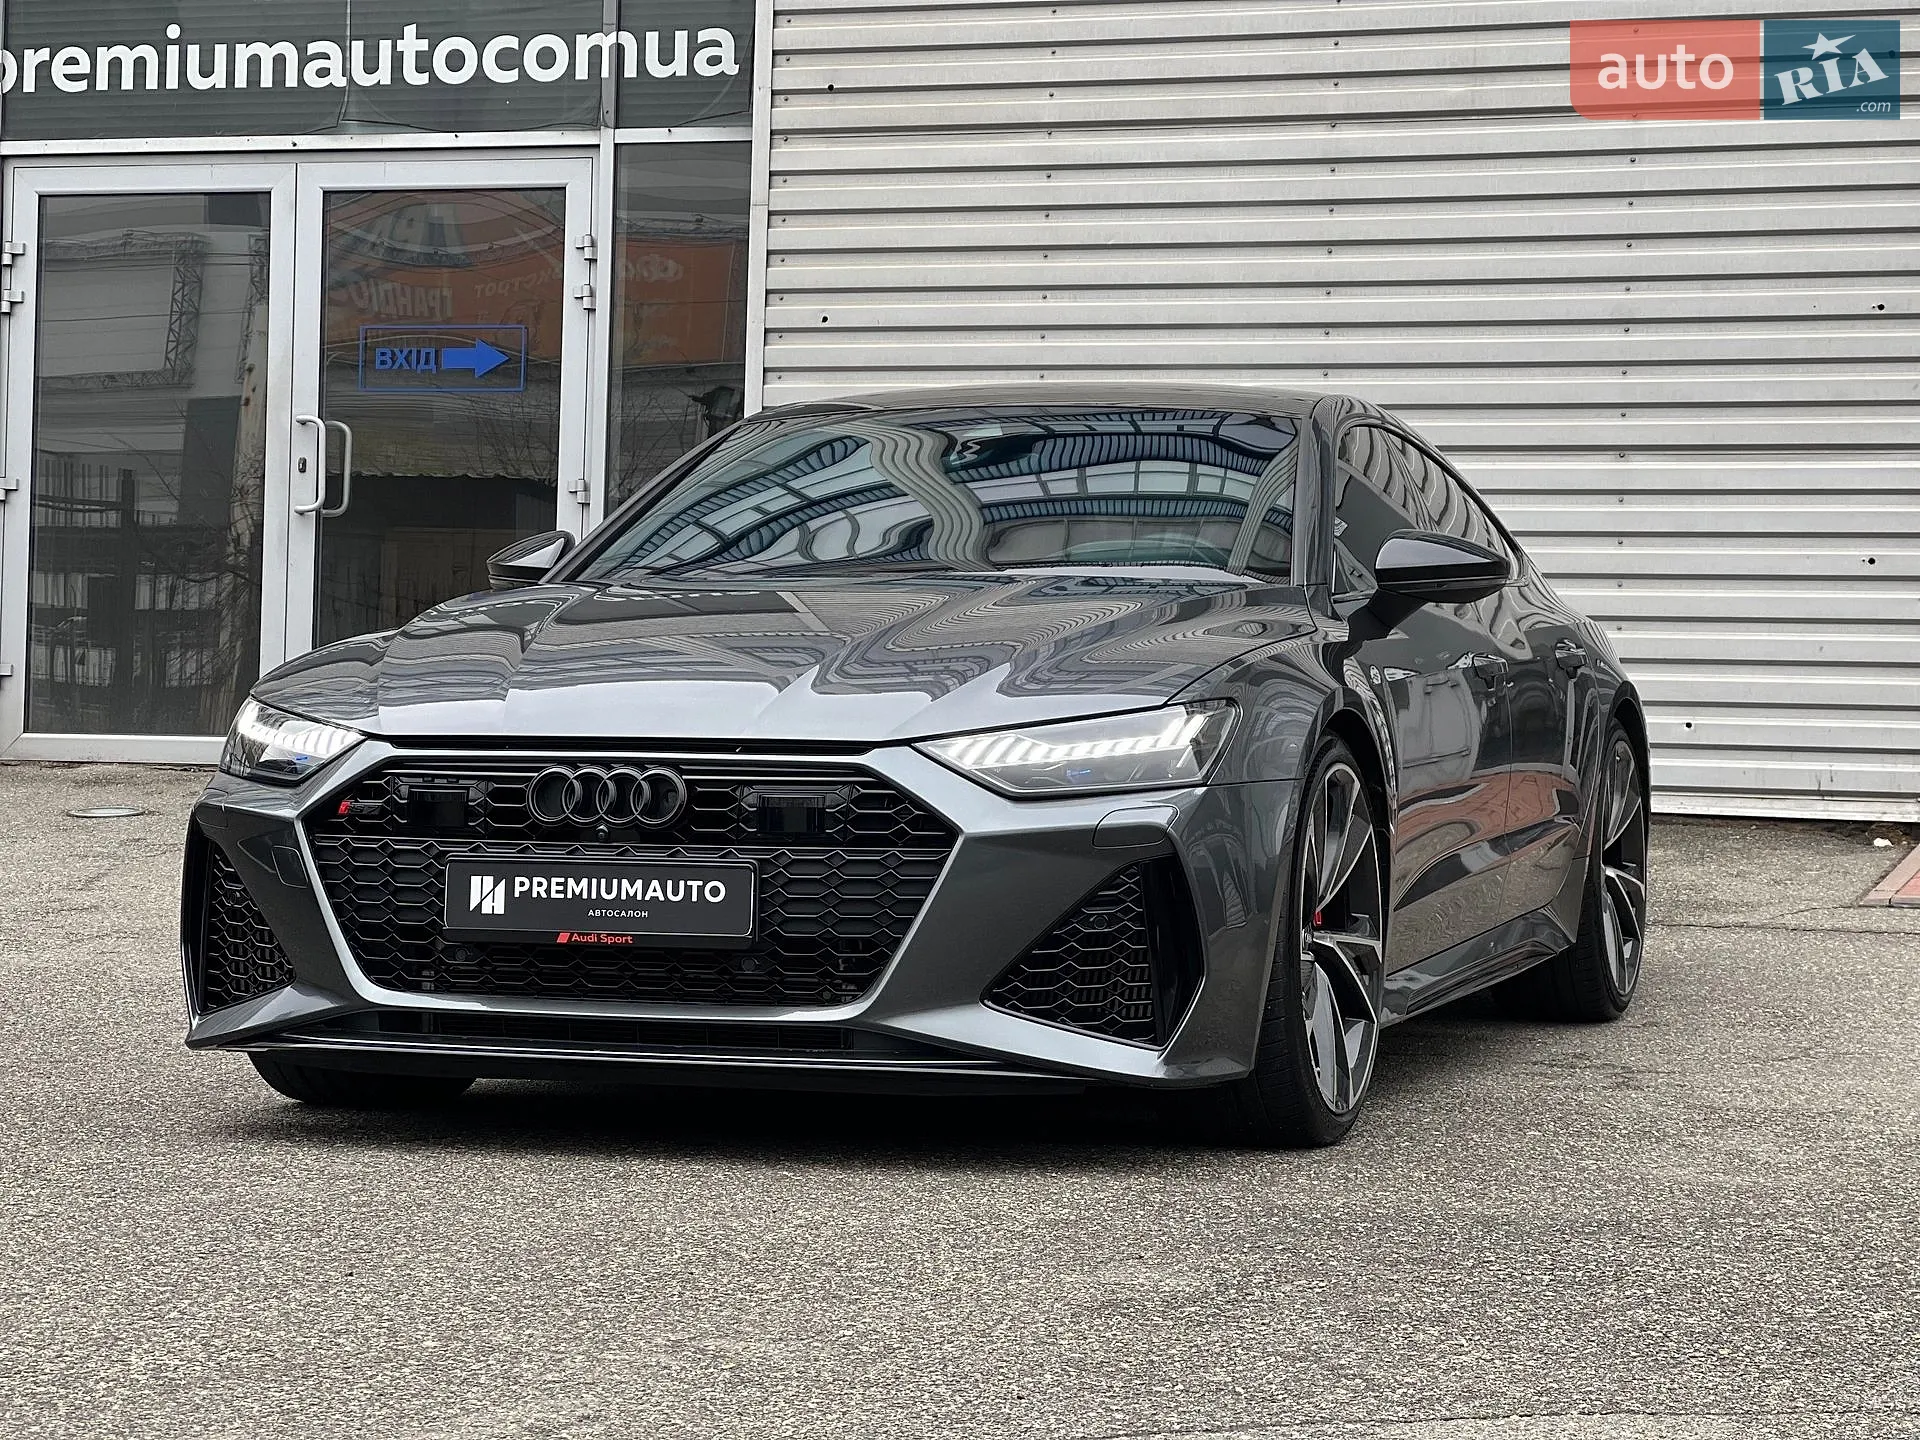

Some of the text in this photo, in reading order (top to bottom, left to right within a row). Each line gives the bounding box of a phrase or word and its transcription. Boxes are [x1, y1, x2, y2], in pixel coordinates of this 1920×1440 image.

[374, 347, 438, 374] ВХІД
[513, 876, 726, 903] PREMIUMAUTO
[587, 908, 649, 919] АВТОСАЛОН
[571, 933, 633, 945] Audi Sport
